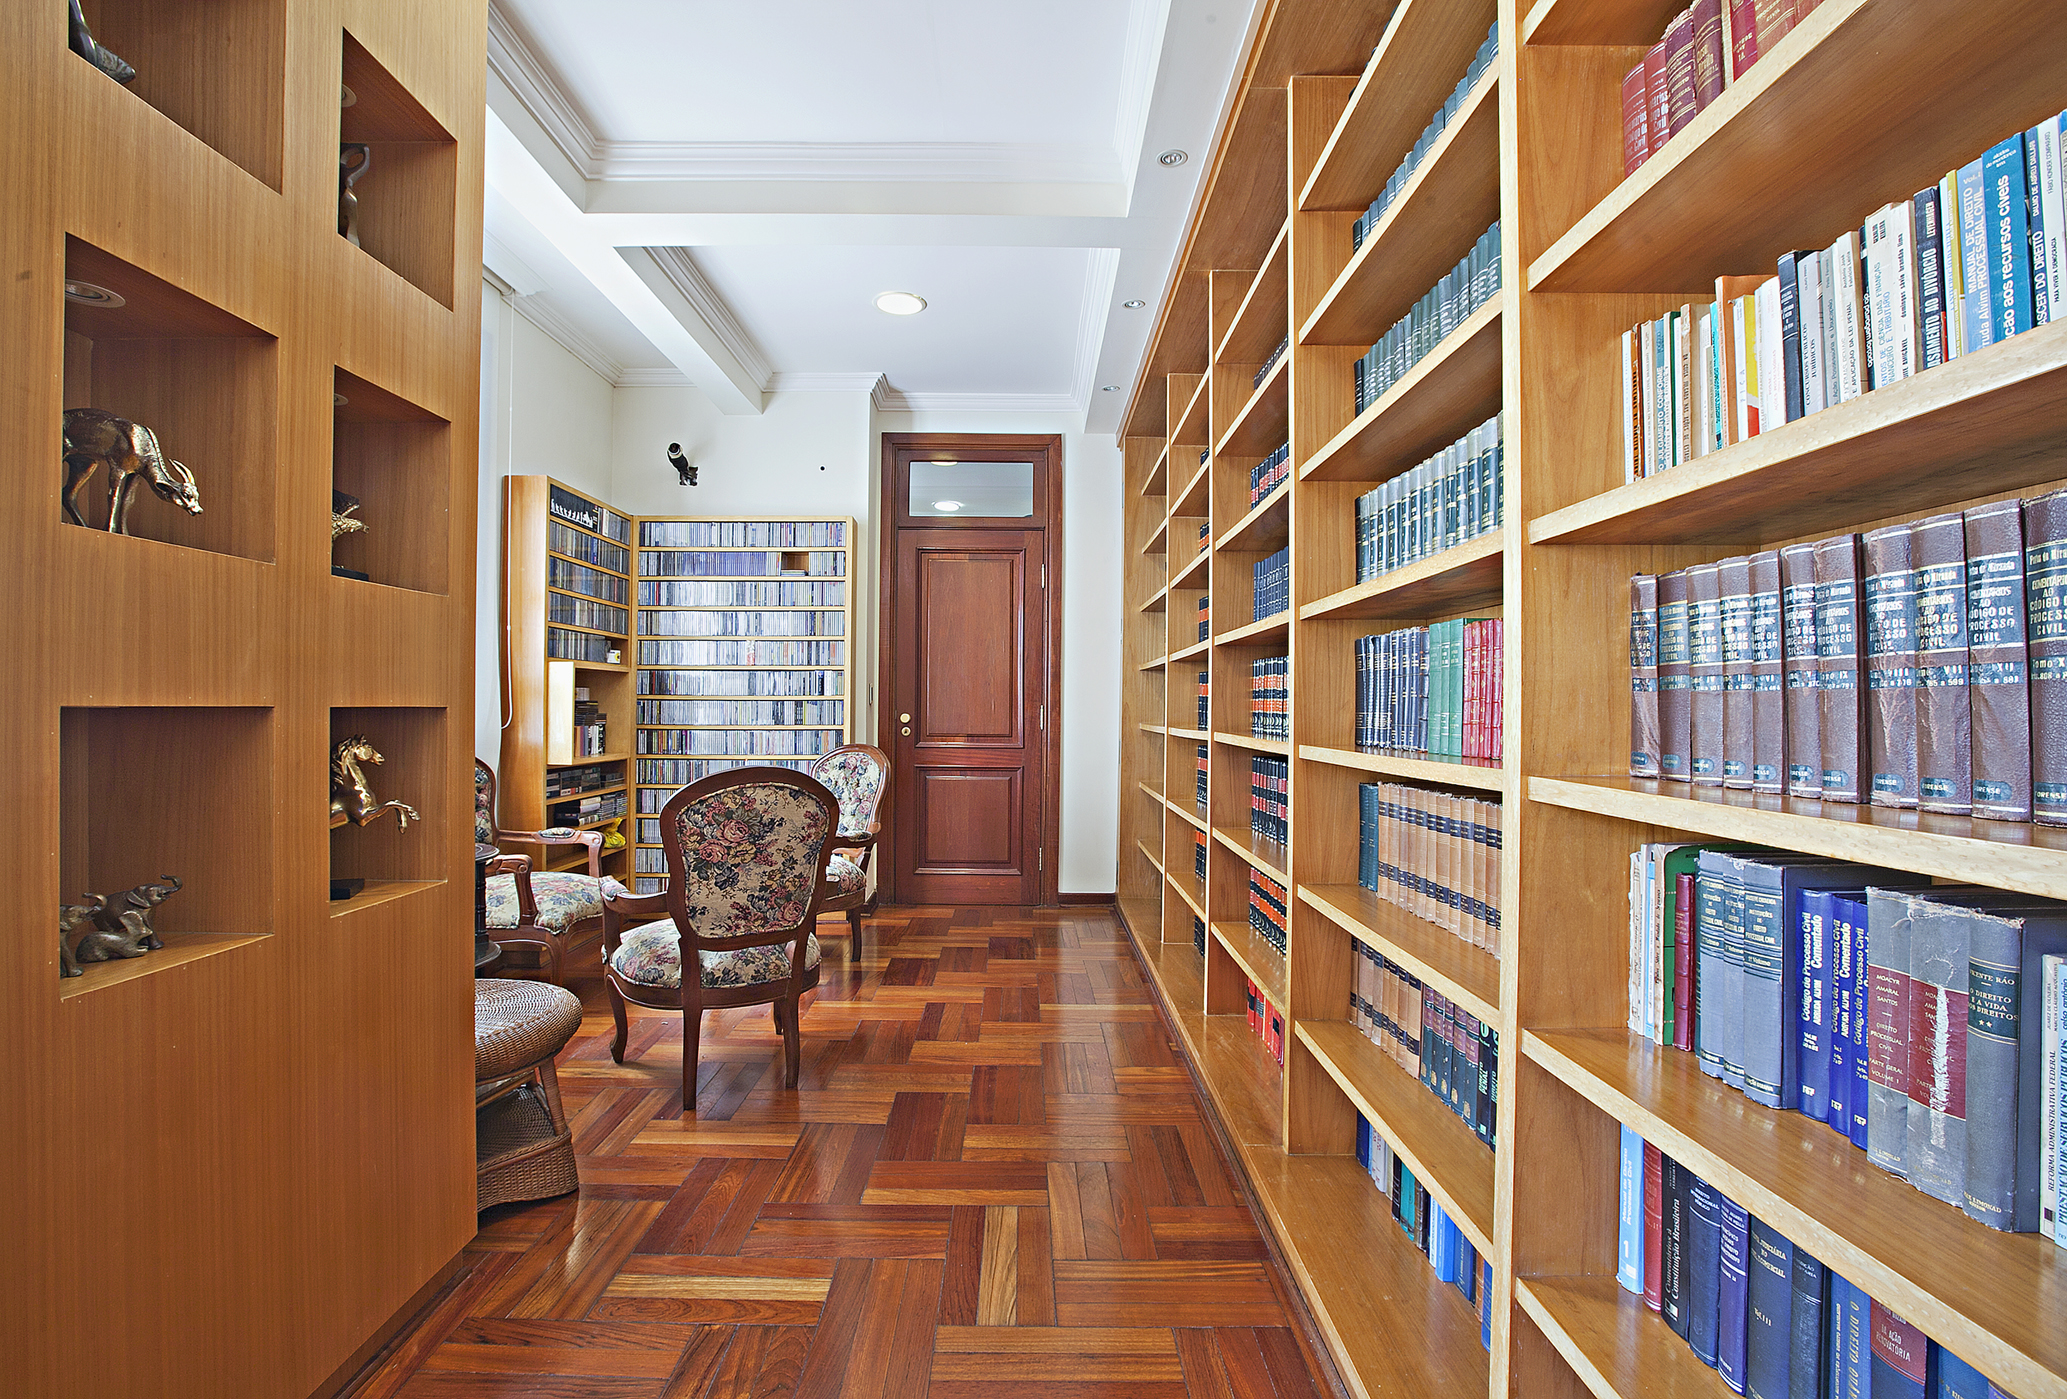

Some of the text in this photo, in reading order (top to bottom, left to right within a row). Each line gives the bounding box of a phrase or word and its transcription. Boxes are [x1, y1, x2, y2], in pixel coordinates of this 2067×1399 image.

[1973, 187, 1984, 215] CIVIL
[1963, 187, 1978, 293] MANUAL DE DIREITO
[1975, 217, 1987, 287] PROCESSUAL
[1998, 217, 2014, 279] recursos
[2001, 280, 2015, 306] aos
[2032, 231, 2047, 325] ASCER DO DIREITO
[1922, 248, 1942, 367] ASAMENTO AO DIVÓRCIO
[1809, 339, 1817, 378] JURÍDICOS
[1880, 363, 1888, 386] ENTOS
[1886, 346, 1895, 383] INANCEIRO
[1656, 367, 1664, 408] CONFORME
[1803, 361, 1811, 406] CONCURSOS
[1657, 411, 1665, 460] JULGAMENTO
[1999, 605, 2014, 616] DE
[2030, 609, 2067, 624] PROCESS
[2036, 623, 2066, 635] CIVIL
[1811, 915, 1822, 969] Comentado
[1840, 922, 1851, 978] Comentado
[1875, 985, 1899, 996] AMARAL
[1876, 975, 1900, 985] MOACYR
[1976, 990, 2011, 1003] DIREITO
[1876, 996, 1898, 1007] SANTOS
[1977, 1006, 2018, 1020] DIREITOS
[1985, 1001, 2007, 1012] VIDA
[1672, 1198, 1681, 1300] Constituição Brasileira
[1849, 1315, 1859, 1363] DIREITO
[1848, 1367, 1860, 1399] QUÂN
